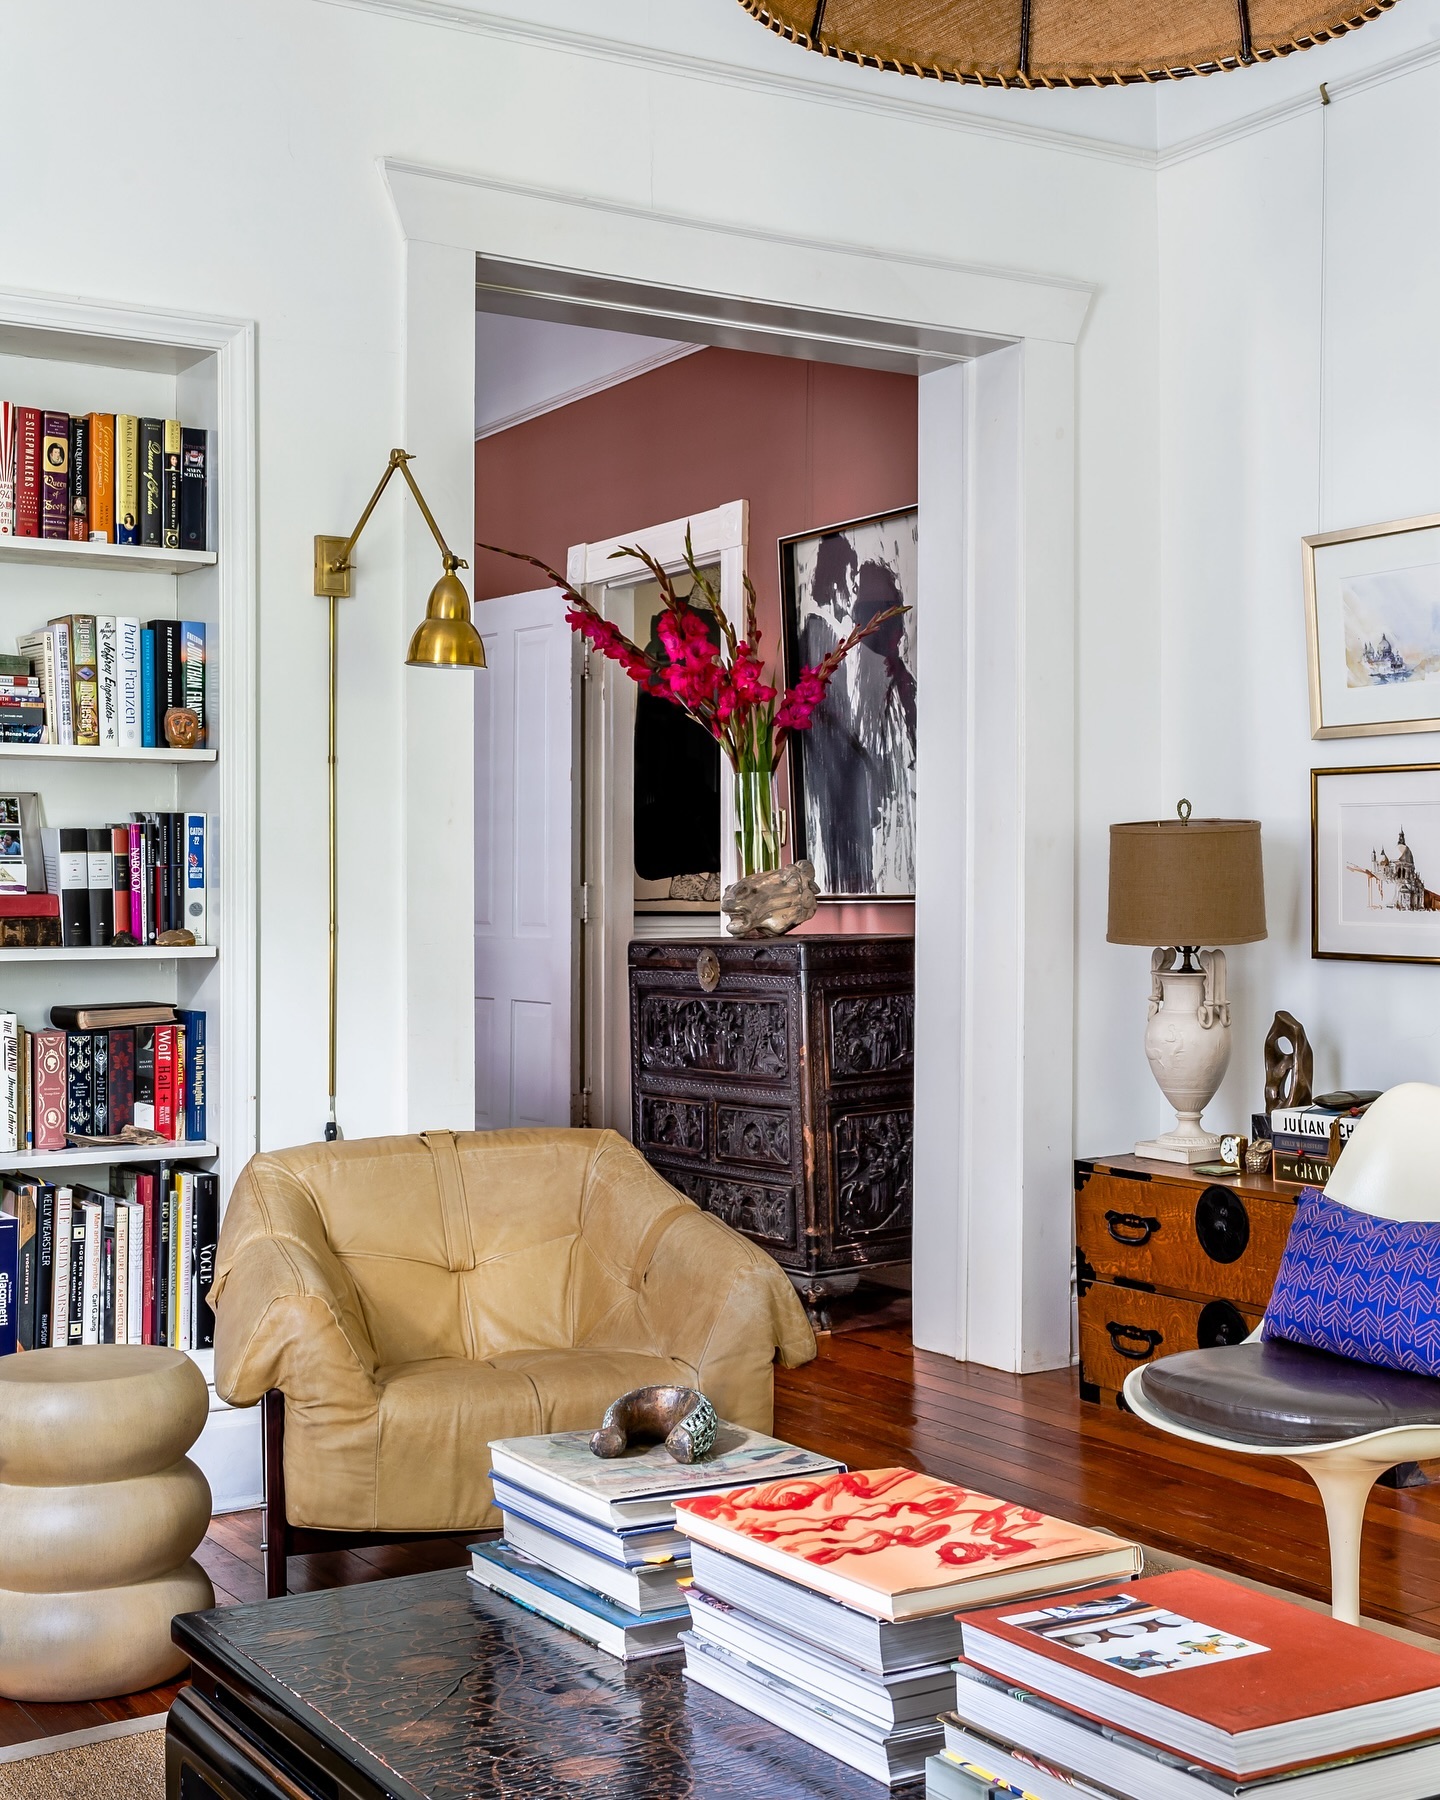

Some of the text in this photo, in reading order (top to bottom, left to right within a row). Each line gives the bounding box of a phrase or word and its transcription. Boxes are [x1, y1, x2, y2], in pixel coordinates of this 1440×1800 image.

[24, 421, 35, 488] SLEEPWALKERS
[75, 448, 83, 471] QUEEN
[148, 440, 161, 471] Queen
[44, 474, 66, 490] Queen
[143, 472, 156, 481] of
[52, 490, 59, 499] of
[58, 632, 66, 646] FRESH
[77, 618, 94, 729] Eugenides Middlesex
[100, 642, 116, 721] Jeffrey Eugenides
[122, 623, 138, 724] Purity Franzen
[186, 642, 203, 688] JONATHAN
[190, 827, 204, 836] CATCH
[131, 847, 140, 893] NABOKOV
[3, 1021, 17, 1072] THE LOWLAND
[158, 1030, 171, 1090] Wolf Hall
[193, 1054, 204, 1065] Kill
[196, 1046, 204, 1054] To
[192, 1070, 204, 1105] Mockingbird
[5, 1075, 16, 1136] Jhumpa Lahiri
[1284, 1117, 1325, 1136] JULIAN
[42, 1194, 52, 1266] KELLY WEARSTLER
[185, 1221, 190, 1229] OF
[56, 1197, 70, 1340] HUE KELLY WEARSTLER
[91, 1257, 99, 1290] Symbols
[118, 1275, 124, 1285] OF
[200, 1244, 216, 1284] VOGUE
[0, 1272, 9, 1326] Giacometti
[40, 1314, 48, 1345] RHAPSODY
